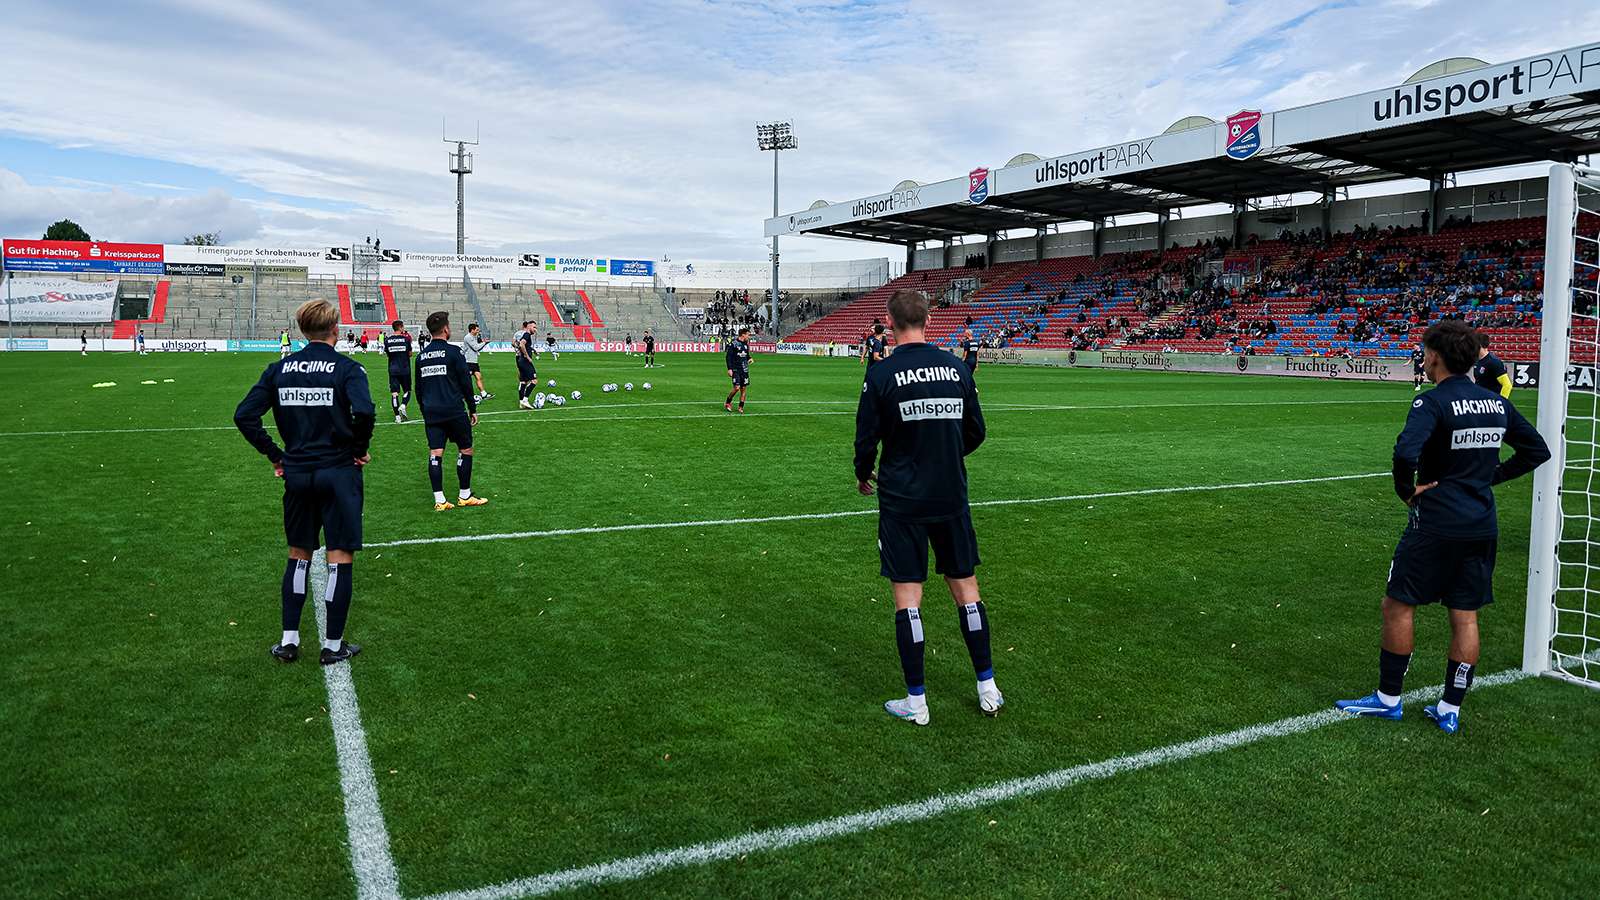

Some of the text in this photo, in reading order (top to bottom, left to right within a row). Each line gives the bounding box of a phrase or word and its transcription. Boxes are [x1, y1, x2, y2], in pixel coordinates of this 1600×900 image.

[1373, 47, 1600, 122] uhlsportPAR
[1035, 139, 1154, 183] uhlsportPARK
[852, 189, 921, 218] uhlsportPARK
[8, 246, 81, 258] Gut für Haching.
[104, 250, 160, 260] Kreissparkasse
[197, 247, 320, 257] Firmengruppe Schrobenhauser
[406, 253, 513, 264] Firmengruppe Schrobenhauser
[559, 258, 593, 266] BAVARIA
[563, 265, 587, 273] petrol
[161, 340, 207, 350] uhlsport
[978, 349, 1023, 363] uchtig. Süffig.
[1101, 352, 1173, 369] Fruchtig. Süffig.
[282, 360, 336, 374] HACHING
[1286, 358, 1391, 378] Fruchtig. Süffig.
[894, 366, 960, 387] HACHING
[1515, 364, 1594, 387] 3. GA
[280, 389, 332, 404] uhlsport
[902, 401, 962, 417] uhlsport
[1451, 399, 1505, 416] HACHING
[1454, 430, 1504, 445] uhlspo
